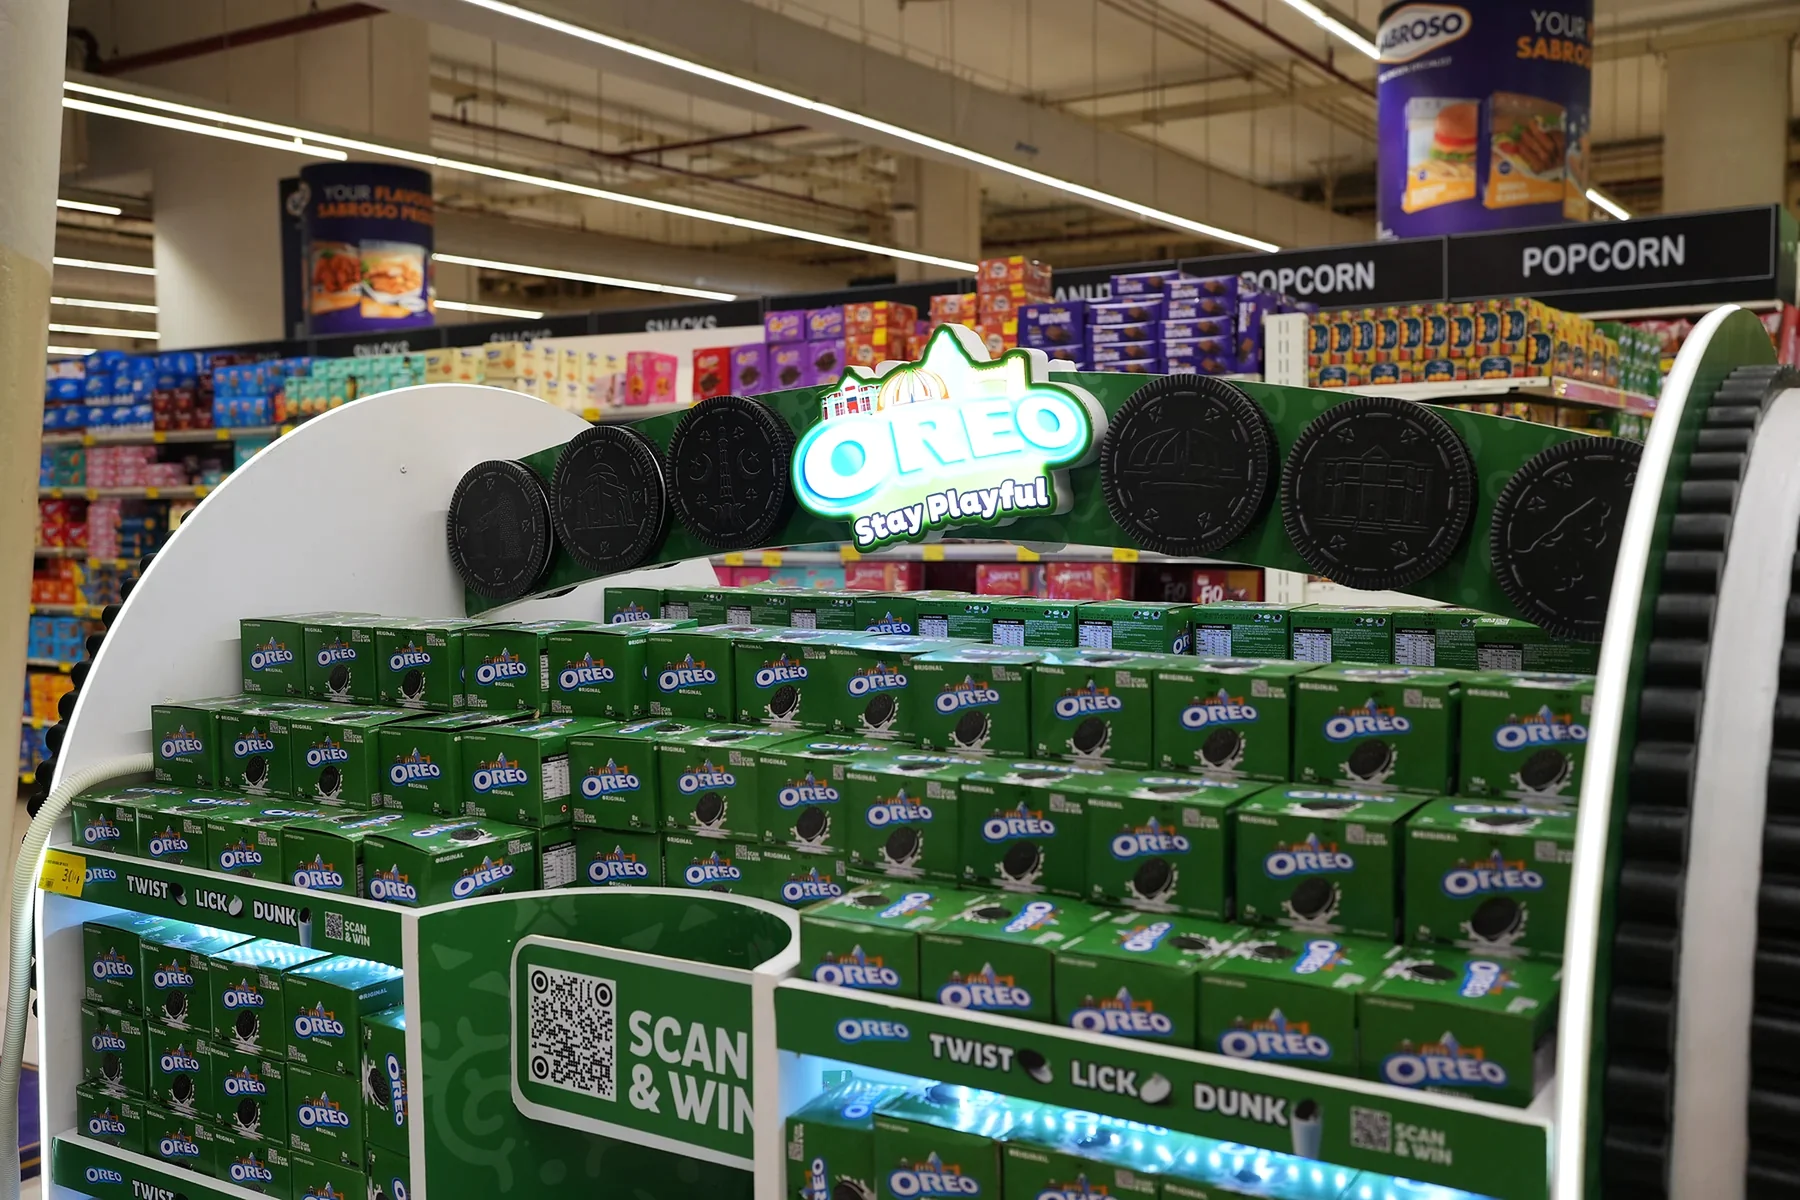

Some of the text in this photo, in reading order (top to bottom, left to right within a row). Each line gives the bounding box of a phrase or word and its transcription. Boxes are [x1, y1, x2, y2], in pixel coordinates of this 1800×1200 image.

[1531, 10, 1586, 39] YOUR
[324, 184, 371, 199] YOUR
[318, 202, 398, 219] SABROSO
[1522, 234, 1685, 278] POPCORN
[645, 314, 717, 332] SNACKS
[804, 393, 1081, 499] OREO
[855, 477, 1049, 545] Stay Playful
[612, 611, 650, 624] OREO
[251, 651, 292, 668] OREO
[318, 649, 355, 664] OREO
[391, 652, 430, 669] OREO
[478, 663, 526, 686] OREO
[561, 666, 613, 687] OREO
[660, 670, 715, 691] OREO
[757, 665, 807, 685] OREO
[850, 675, 906, 694] OREO
[937, 688, 999, 711] OREO
[1057, 696, 1121, 716] OREO
[1183, 705, 1256, 726] OREO
[1326, 715, 1409, 738] OREO
[1497, 724, 1587, 750] OREO
[162, 740, 202, 757] OREO
[235, 740, 273, 755] OREO
[307, 749, 347, 764] OREO
[391, 764, 439, 784] OREO
[474, 768, 527, 789] OREO
[680, 773, 734, 791] OREO
[583, 774, 638, 796] OREO
[780, 787, 838, 805] OREO
[868, 805, 932, 824] OREO
[85, 827, 119, 841] OREO
[984, 819, 1054, 839] OREO
[150, 839, 188, 854] OREO
[1113, 834, 1188, 856] OREO
[221, 851, 261, 867] OREO
[1267, 849, 1353, 875] OREO
[84, 869, 116, 882] OREO
[294, 871, 342, 889] OREO
[590, 862, 647, 880] OREO
[686, 866, 740, 883] OREO
[371, 880, 416, 899] OREO
[455, 865, 513, 897] OREO
[1445, 870, 1542, 894] OREO
[126, 875, 297, 927] TWIST LICK DUNK
[784, 883, 840, 900] OREO
[344, 921, 367, 934] SCAN
[344, 932, 371, 947] & WIN
[93, 962, 133, 977] OREO
[155, 972, 193, 986] OREO
[815, 965, 898, 986] OREO
[224, 992, 263, 1006] OREO
[359, 988, 387, 1000] ORIGINAL
[940, 985, 1030, 1009] OREO
[296, 1017, 343, 1035] OREO
[838, 1020, 908, 1039] OREO
[1072, 1009, 1171, 1033] OREO
[92, 1036, 125, 1049] OREO
[628, 1010, 748, 1080] SCAN
[1222, 1032, 1329, 1057] OREO
[161, 1056, 198, 1070] OREO
[1386, 1054, 1505, 1083] OREO
[225, 1079, 265, 1093] OREO
[930, 1033, 1015, 1072] TWIST
[1072, 1060, 1138, 1097] LICK
[1195, 1083, 1289, 1126] DUNK
[388, 1056, 403, 1125] OREO
[628, 1063, 755, 1135] & WIN
[299, 1107, 348, 1125] OREO
[90, 1120, 125, 1133] OREO
[1395, 1123, 1446, 1145] SCAN
[161, 1140, 198, 1154] OREO
[1395, 1141, 1452, 1165] & WIN
[87, 1168, 121, 1181] OREO
[231, 1165, 271, 1179] OREO
[132, 1179, 176, 1200] TWIST
[891, 1172, 977, 1195] OREO
